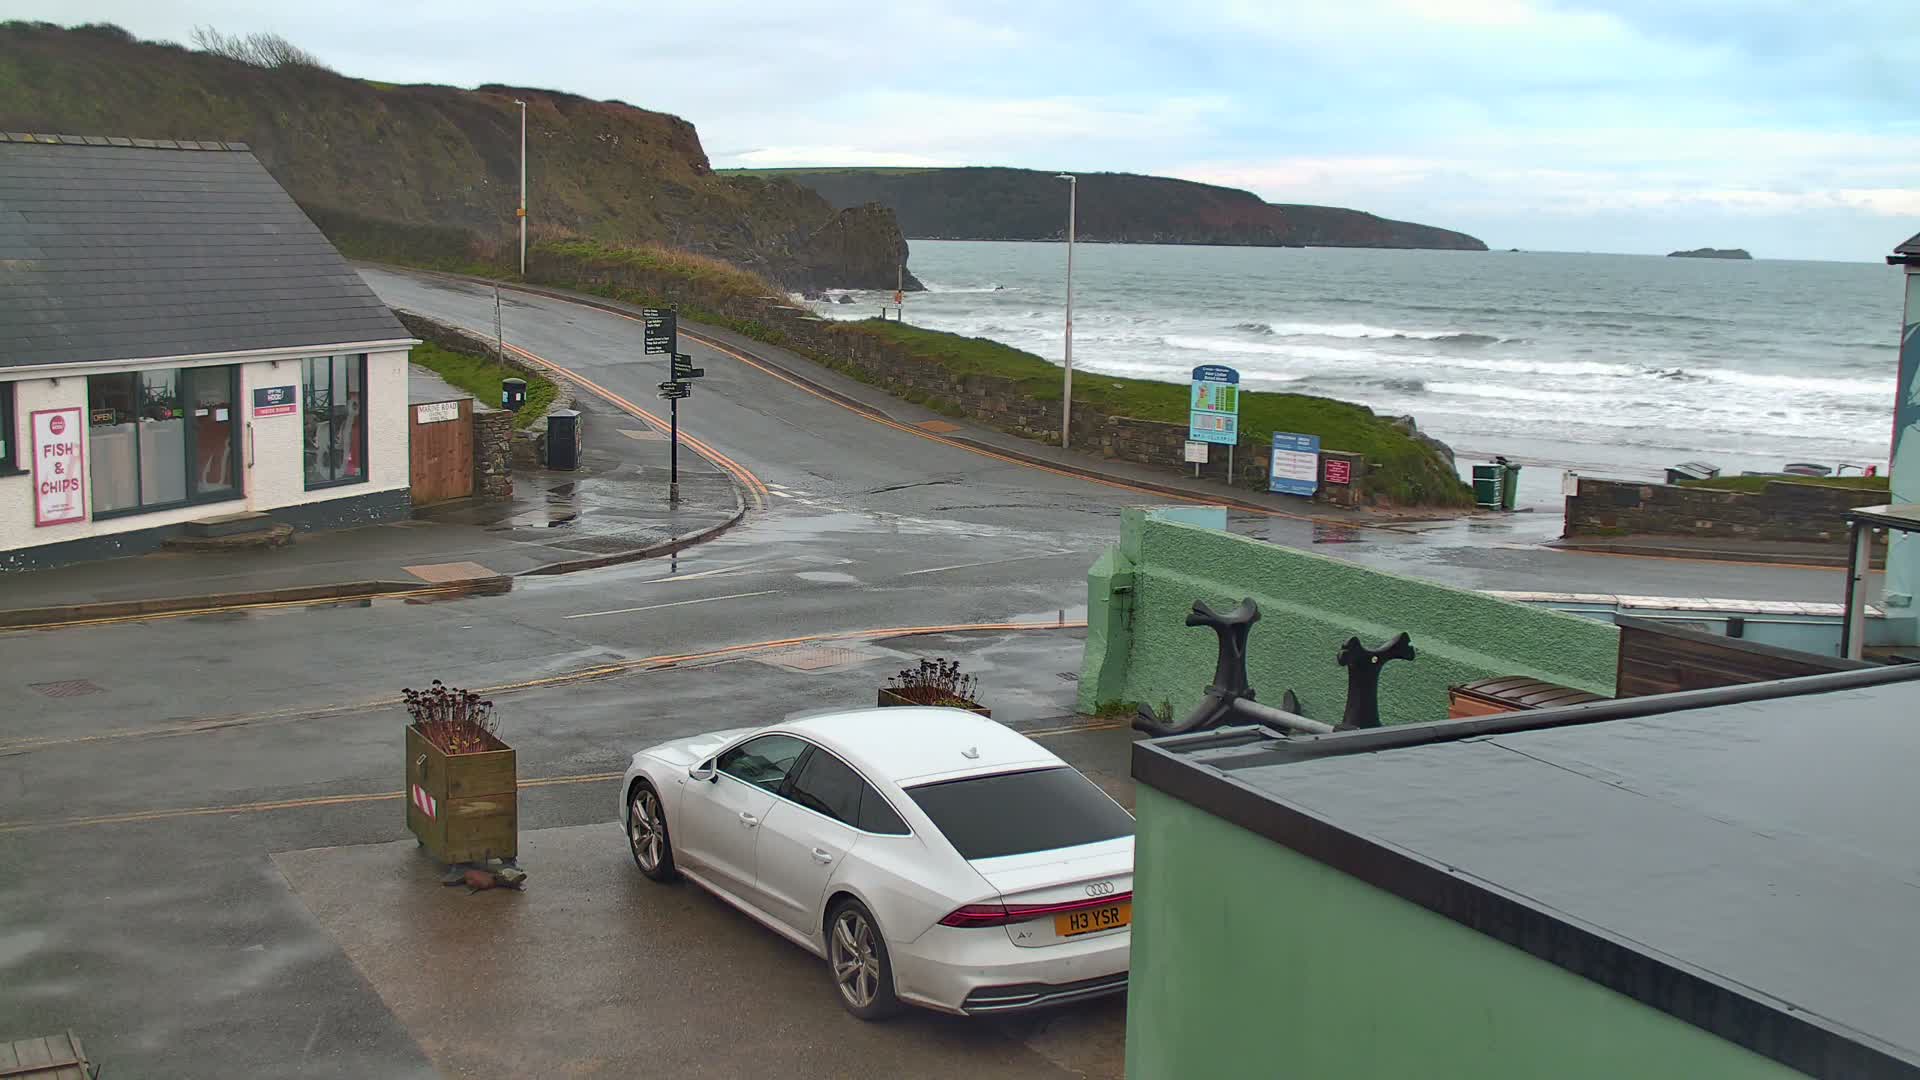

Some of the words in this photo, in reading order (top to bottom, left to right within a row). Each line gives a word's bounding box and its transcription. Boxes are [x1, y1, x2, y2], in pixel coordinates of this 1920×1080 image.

[441, 402, 457, 411] ROAD
[93, 413, 113, 422] OPEN
[43, 443, 73, 458] FISH
[54, 462, 64, 474] &
[41, 478, 79, 495] CHIPS
[1070, 913, 1089, 931] H3
[1092, 907, 1120, 926] YSR
